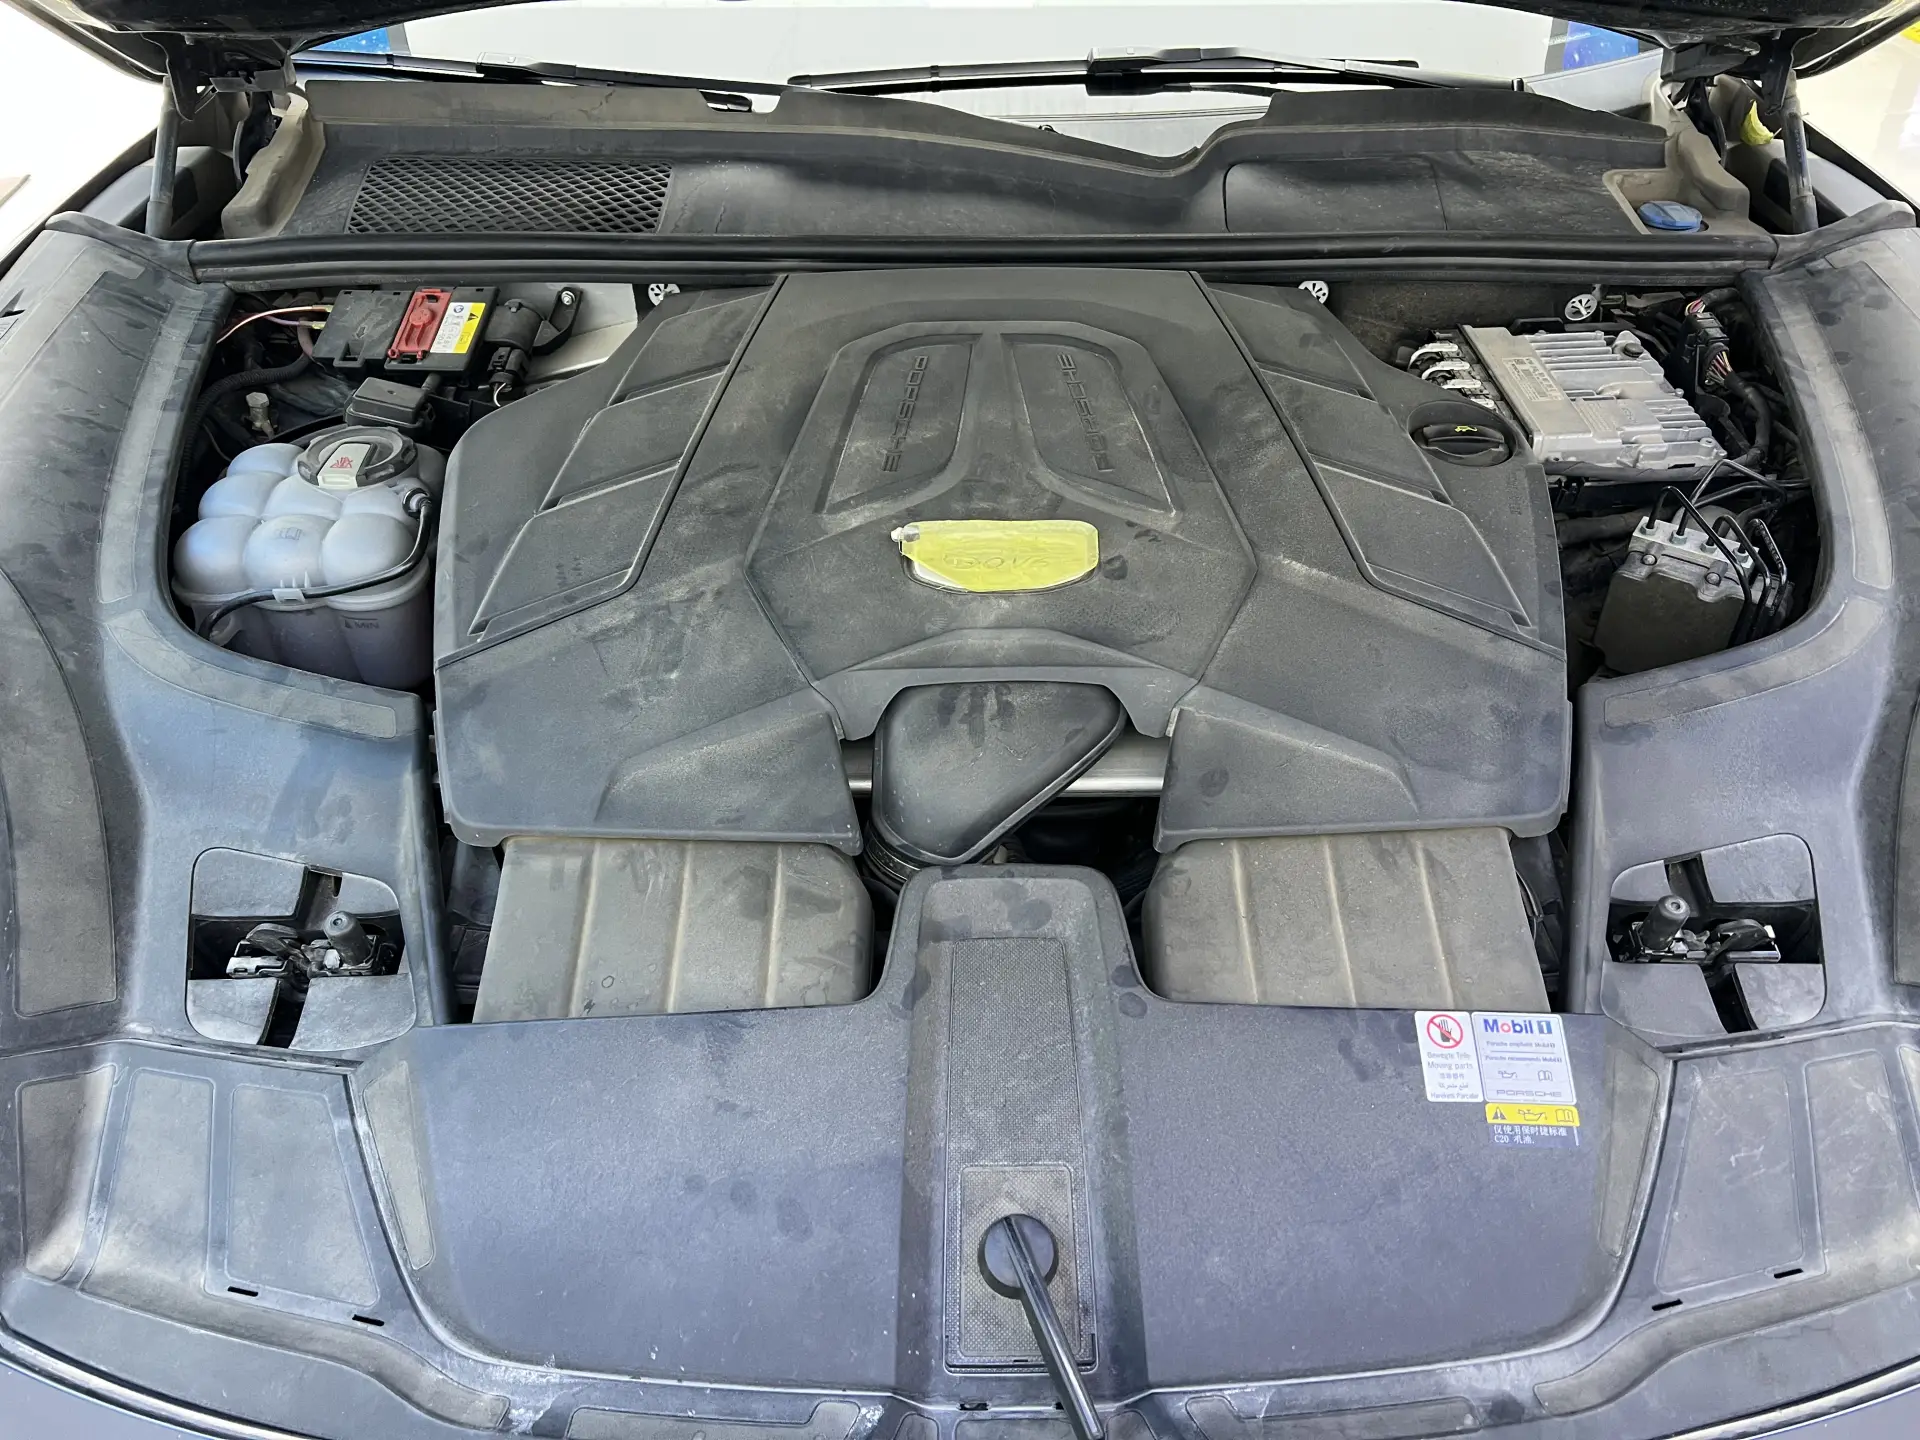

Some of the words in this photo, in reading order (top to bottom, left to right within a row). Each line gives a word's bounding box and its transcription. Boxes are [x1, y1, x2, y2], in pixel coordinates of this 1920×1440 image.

[882, 355, 928, 472] PORSCHE
[1483, 1018, 1534, 1034] Mobil
[1537, 1020, 1552, 1034] 1
[1427, 1061, 1454, 1071] Moving
[1455, 1062, 1474, 1071] parts
[1496, 1089, 1562, 1098] PORSCHE
[1493, 1124, 1568, 1137] 仅使用保时捷标准
[1494, 1135, 1509, 1144] C20
